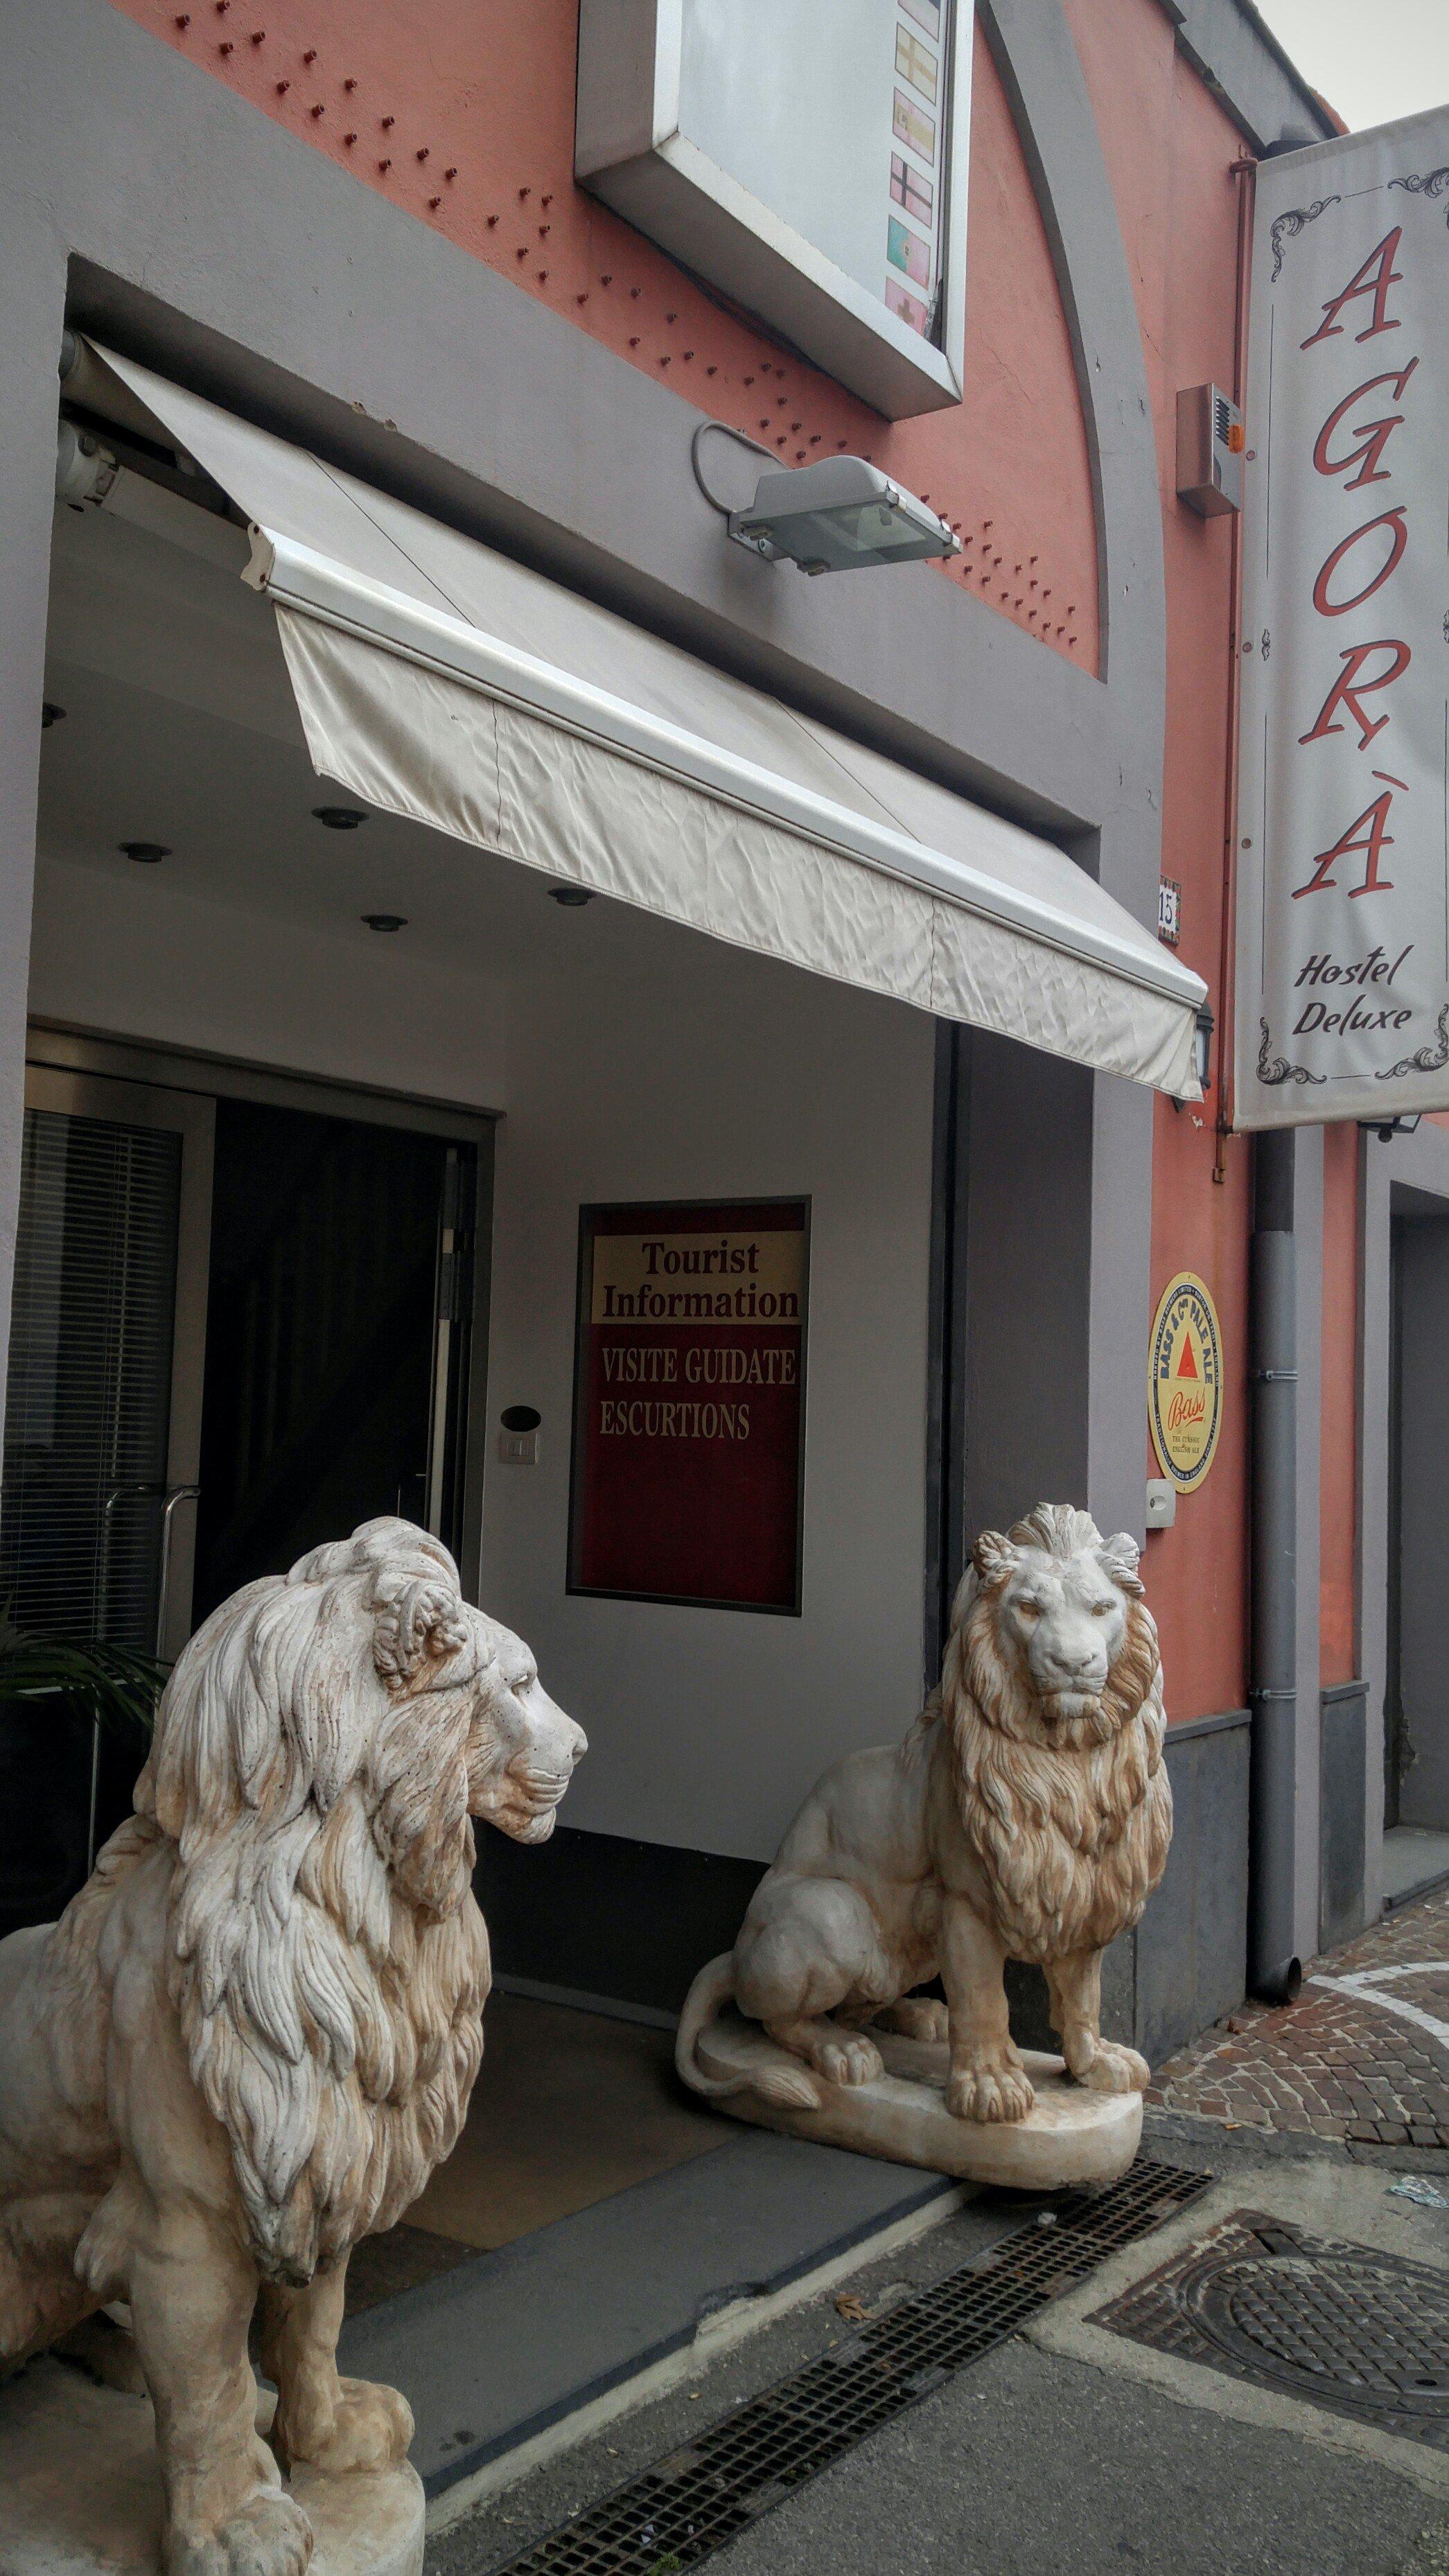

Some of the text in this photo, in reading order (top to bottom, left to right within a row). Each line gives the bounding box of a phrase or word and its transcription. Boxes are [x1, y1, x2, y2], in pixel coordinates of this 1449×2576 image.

[1159, 891, 1173, 925] 15
[1294, 945, 1415, 987] Hostel
[1292, 994, 1412, 1036] Deluxe
[642, 1240, 759, 1274] Tourist
[601, 1282, 800, 1317] Information
[1161, 1329, 1174, 1379] BASS
[1190, 1300, 1209, 1344] PALE
[1202, 1347, 1213, 1385] ALE
[601, 1347, 796, 1385] VISITE GUIDATE
[599, 1401, 750, 1440] ESCURTIONS
[1168, 1387, 1206, 1431] Bass
